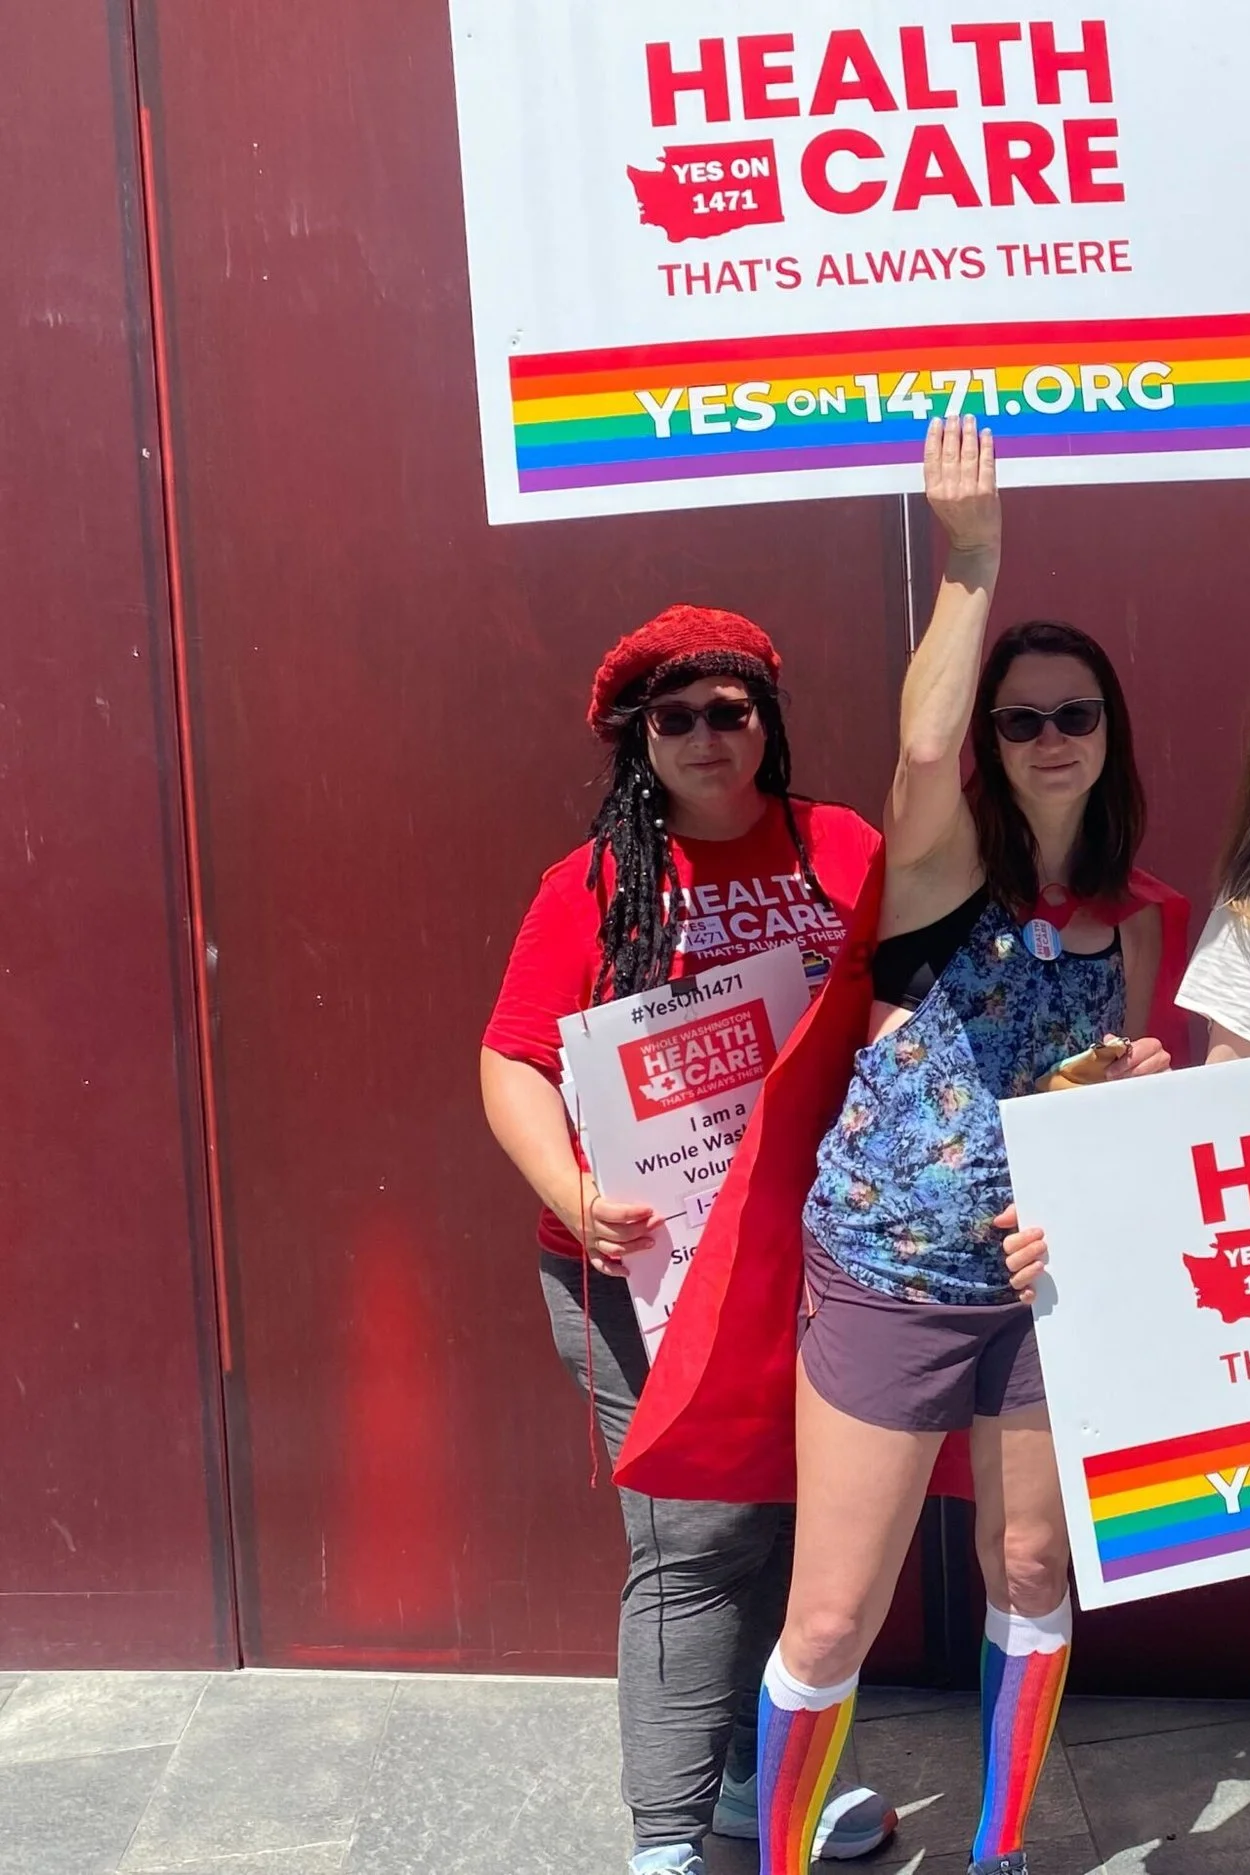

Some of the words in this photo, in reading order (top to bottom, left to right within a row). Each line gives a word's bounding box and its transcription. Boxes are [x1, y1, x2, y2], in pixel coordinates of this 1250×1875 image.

[646, 19, 1114, 128] HEALTH
[671, 161, 725, 184] YES
[731, 157, 771, 180] ON
[799, 117, 1126, 215] CARE
[691, 188, 759, 214] 1471
[659, 256, 803, 296] THAT'S
[816, 244, 986, 287] ALWAYS
[997, 239, 1132, 276] THERE
[635, 381, 777, 439] YES
[787, 388, 847, 417] ON
[854, 360, 1175, 424] 1471.ORG
[687, 931, 725, 947] 1471
[729, 902, 843, 940] CARE
[696, 944, 746, 961] THAT'S
[631, 973, 743, 1024] #YesOn1471
[640, 1036, 679, 1055] WHOLE
[679, 1011, 752, 1041] WASHINGTON
[643, 1020, 757, 1077] HEALTH
[685, 1042, 763, 1086] CARE
[660, 1089, 696, 1107] THAT'S
[696, 1075, 736, 1096] ALWAYS
[690, 1116, 697, 1132] I
[702, 1108, 731, 1128] am
[735, 1103, 746, 1116] a
[635, 1145, 699, 1175] Whole
